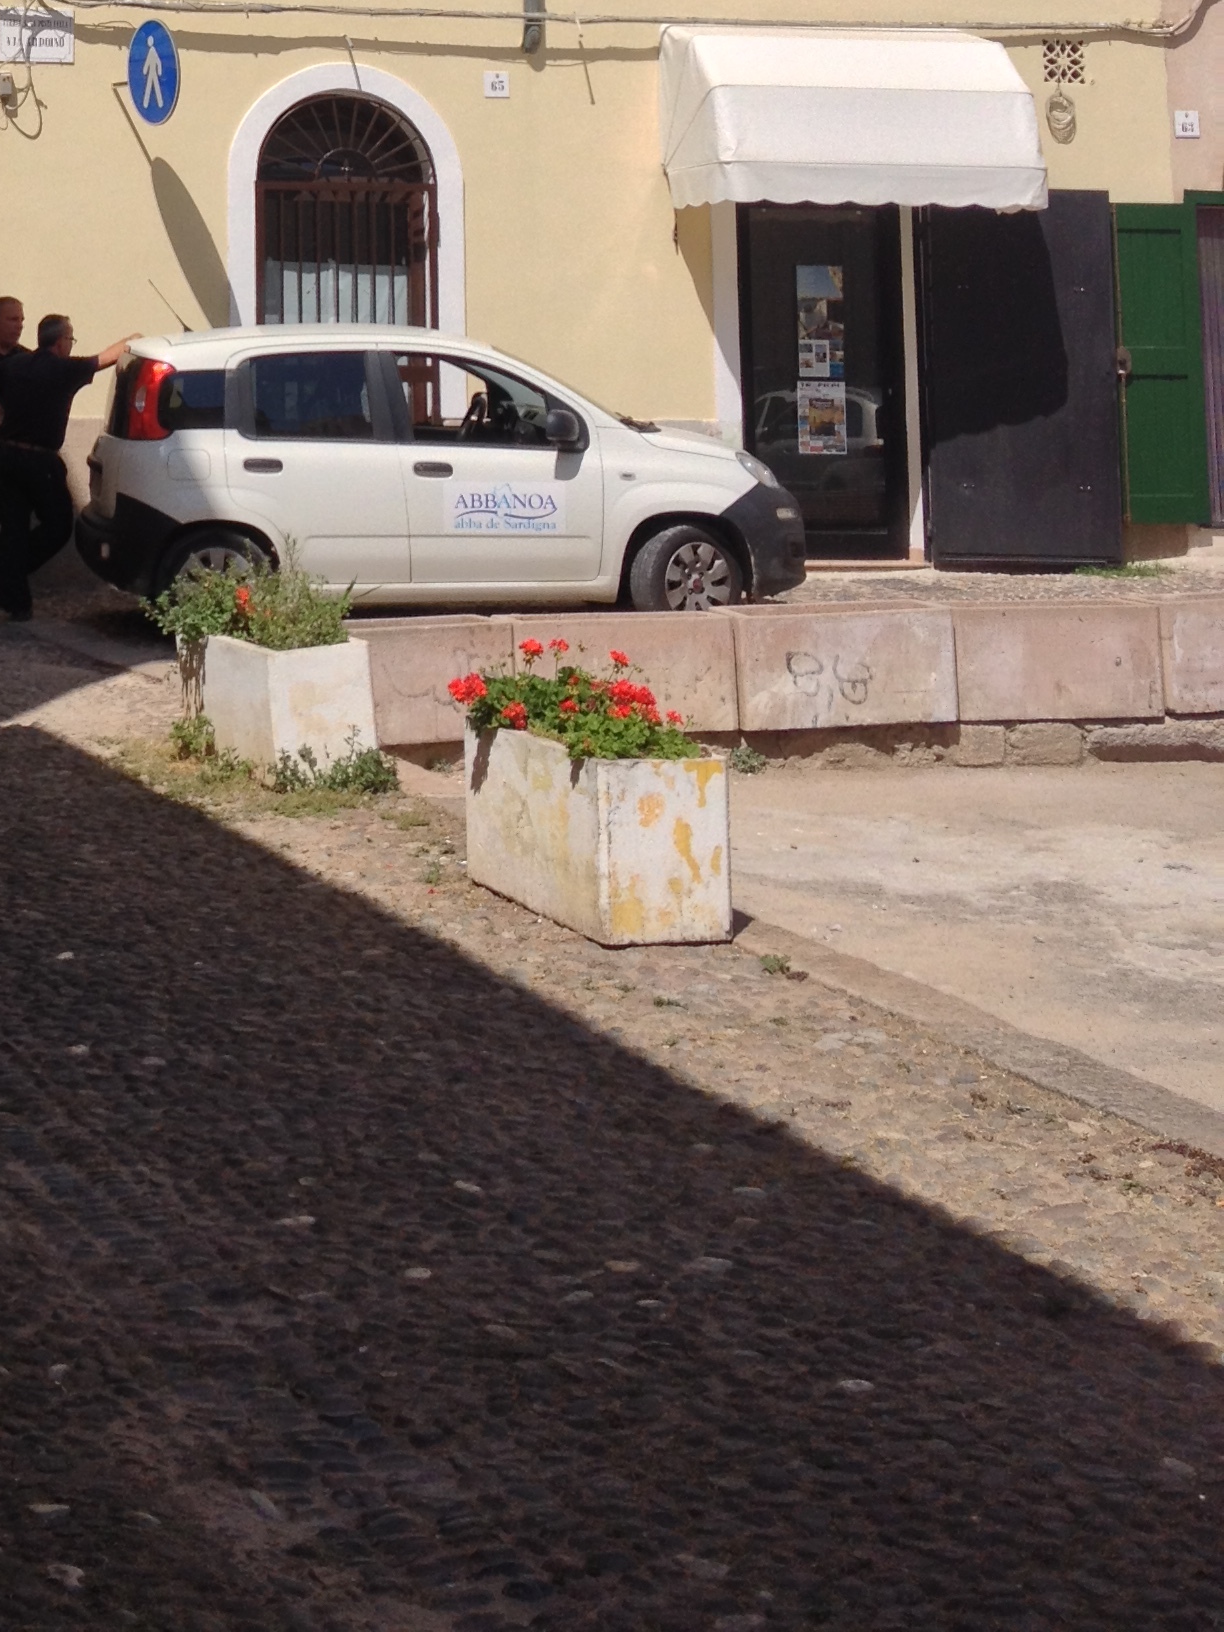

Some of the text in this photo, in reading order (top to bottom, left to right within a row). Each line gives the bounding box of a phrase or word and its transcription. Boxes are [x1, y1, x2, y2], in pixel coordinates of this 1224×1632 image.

[490, 80, 505, 92] 65
[454, 493, 558, 510] ABBANOA
[454, 517, 557, 532] abba de Sardigna
